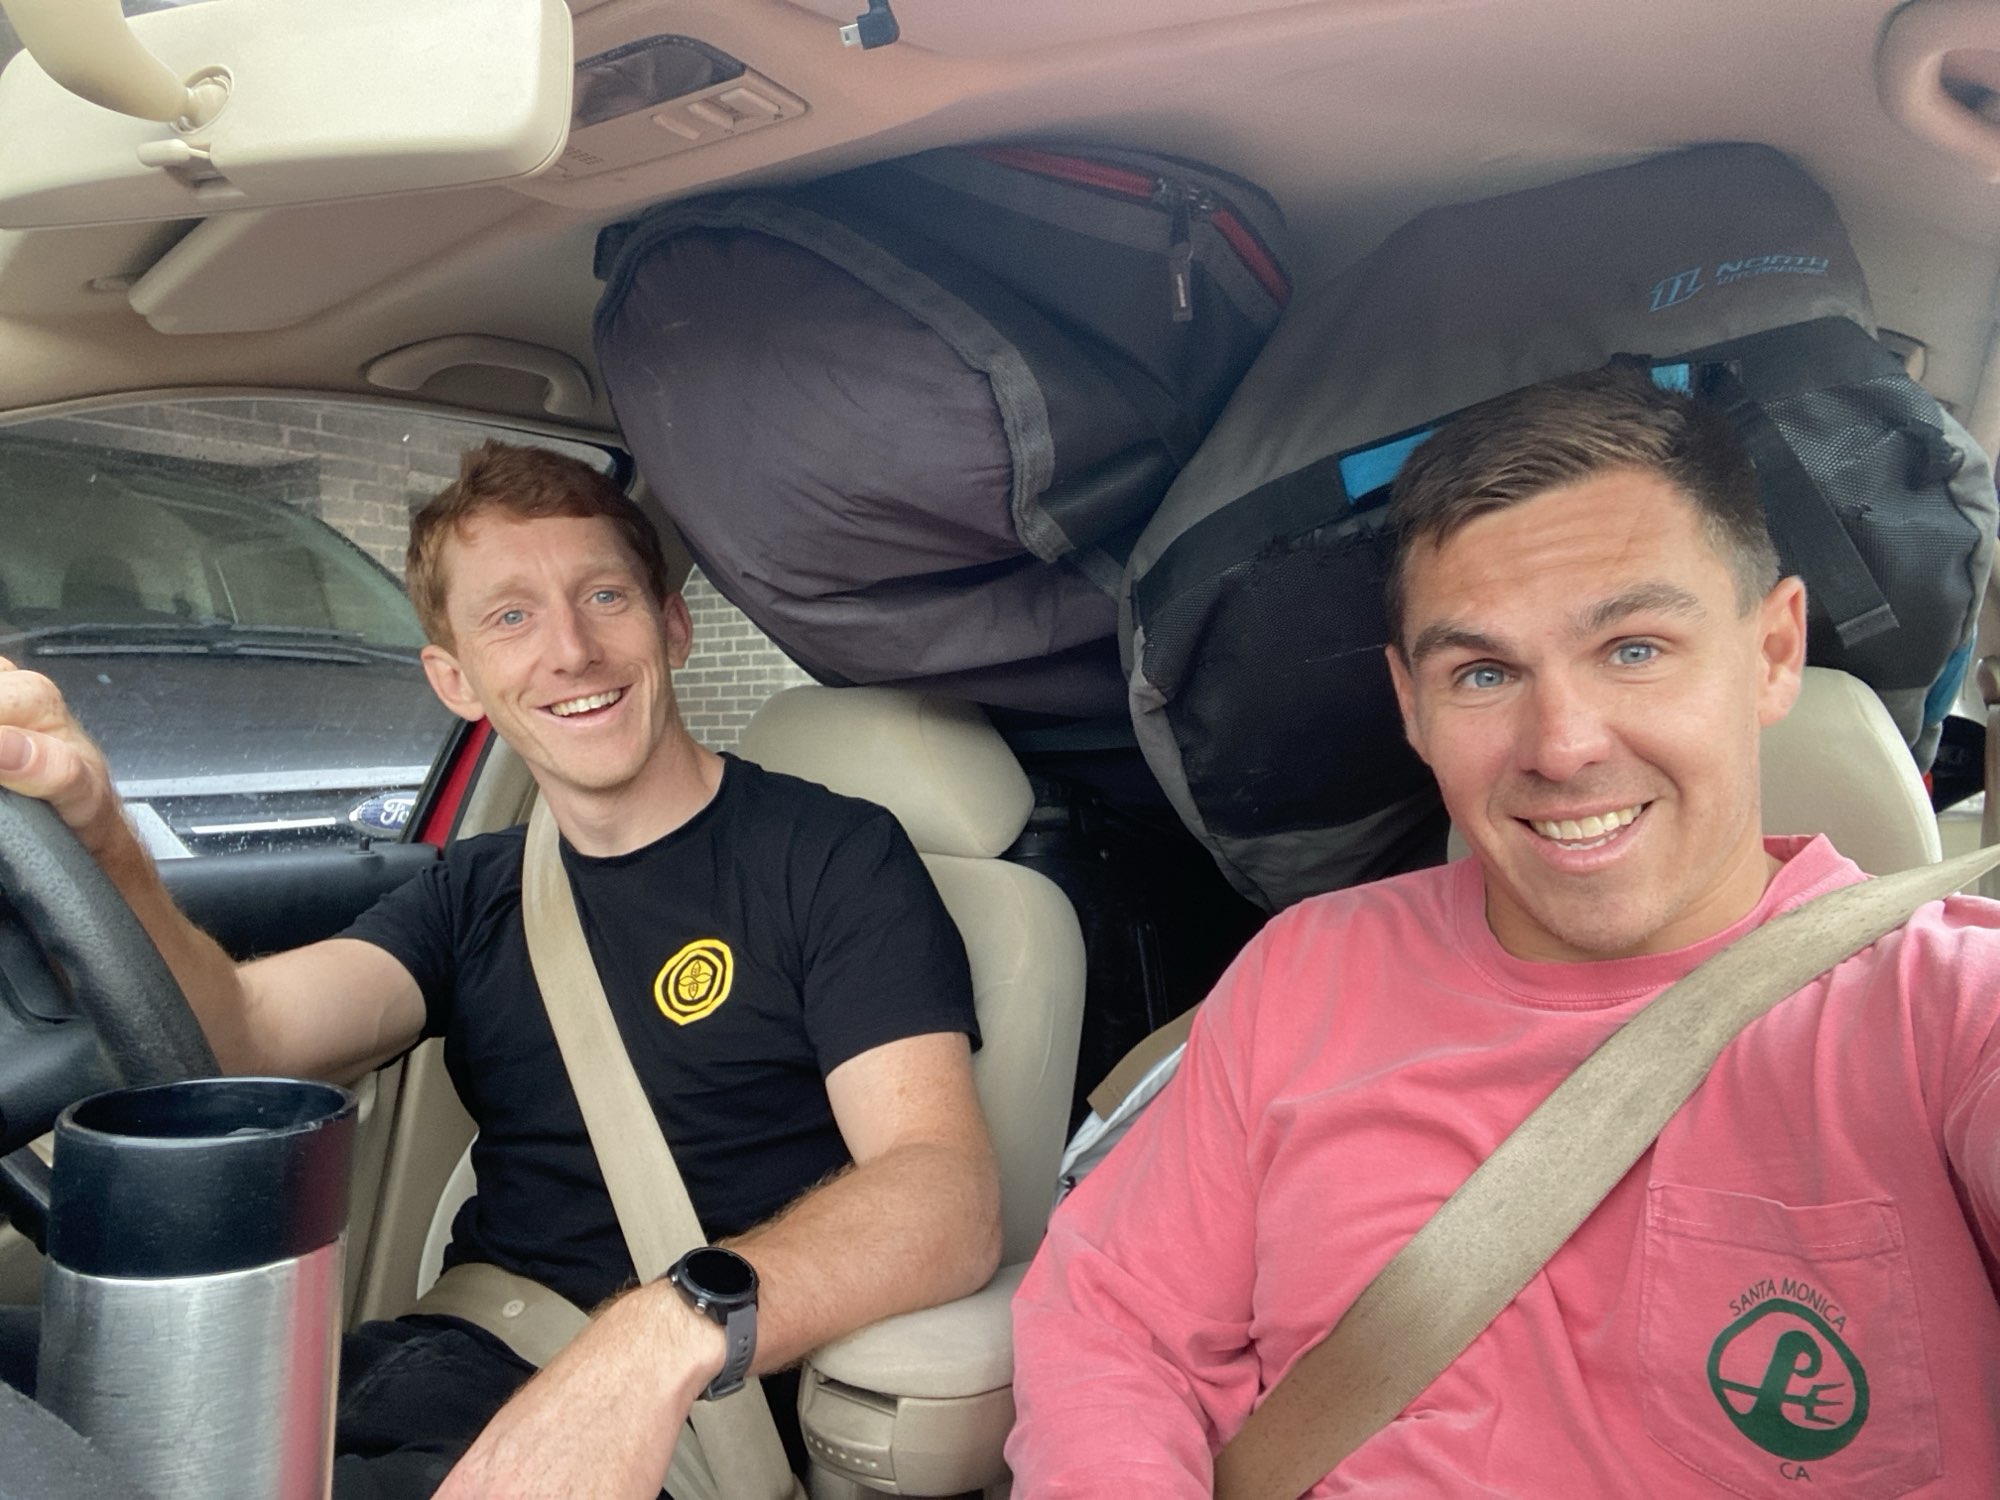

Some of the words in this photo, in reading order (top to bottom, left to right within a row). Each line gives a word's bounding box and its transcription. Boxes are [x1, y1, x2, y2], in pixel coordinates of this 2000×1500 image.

[1715, 255, 1830, 277] NORTH
[1728, 1278, 1777, 1317] SANTA
[1781, 1277, 1847, 1333] MONICA
[1779, 1462, 1813, 1483] CA
